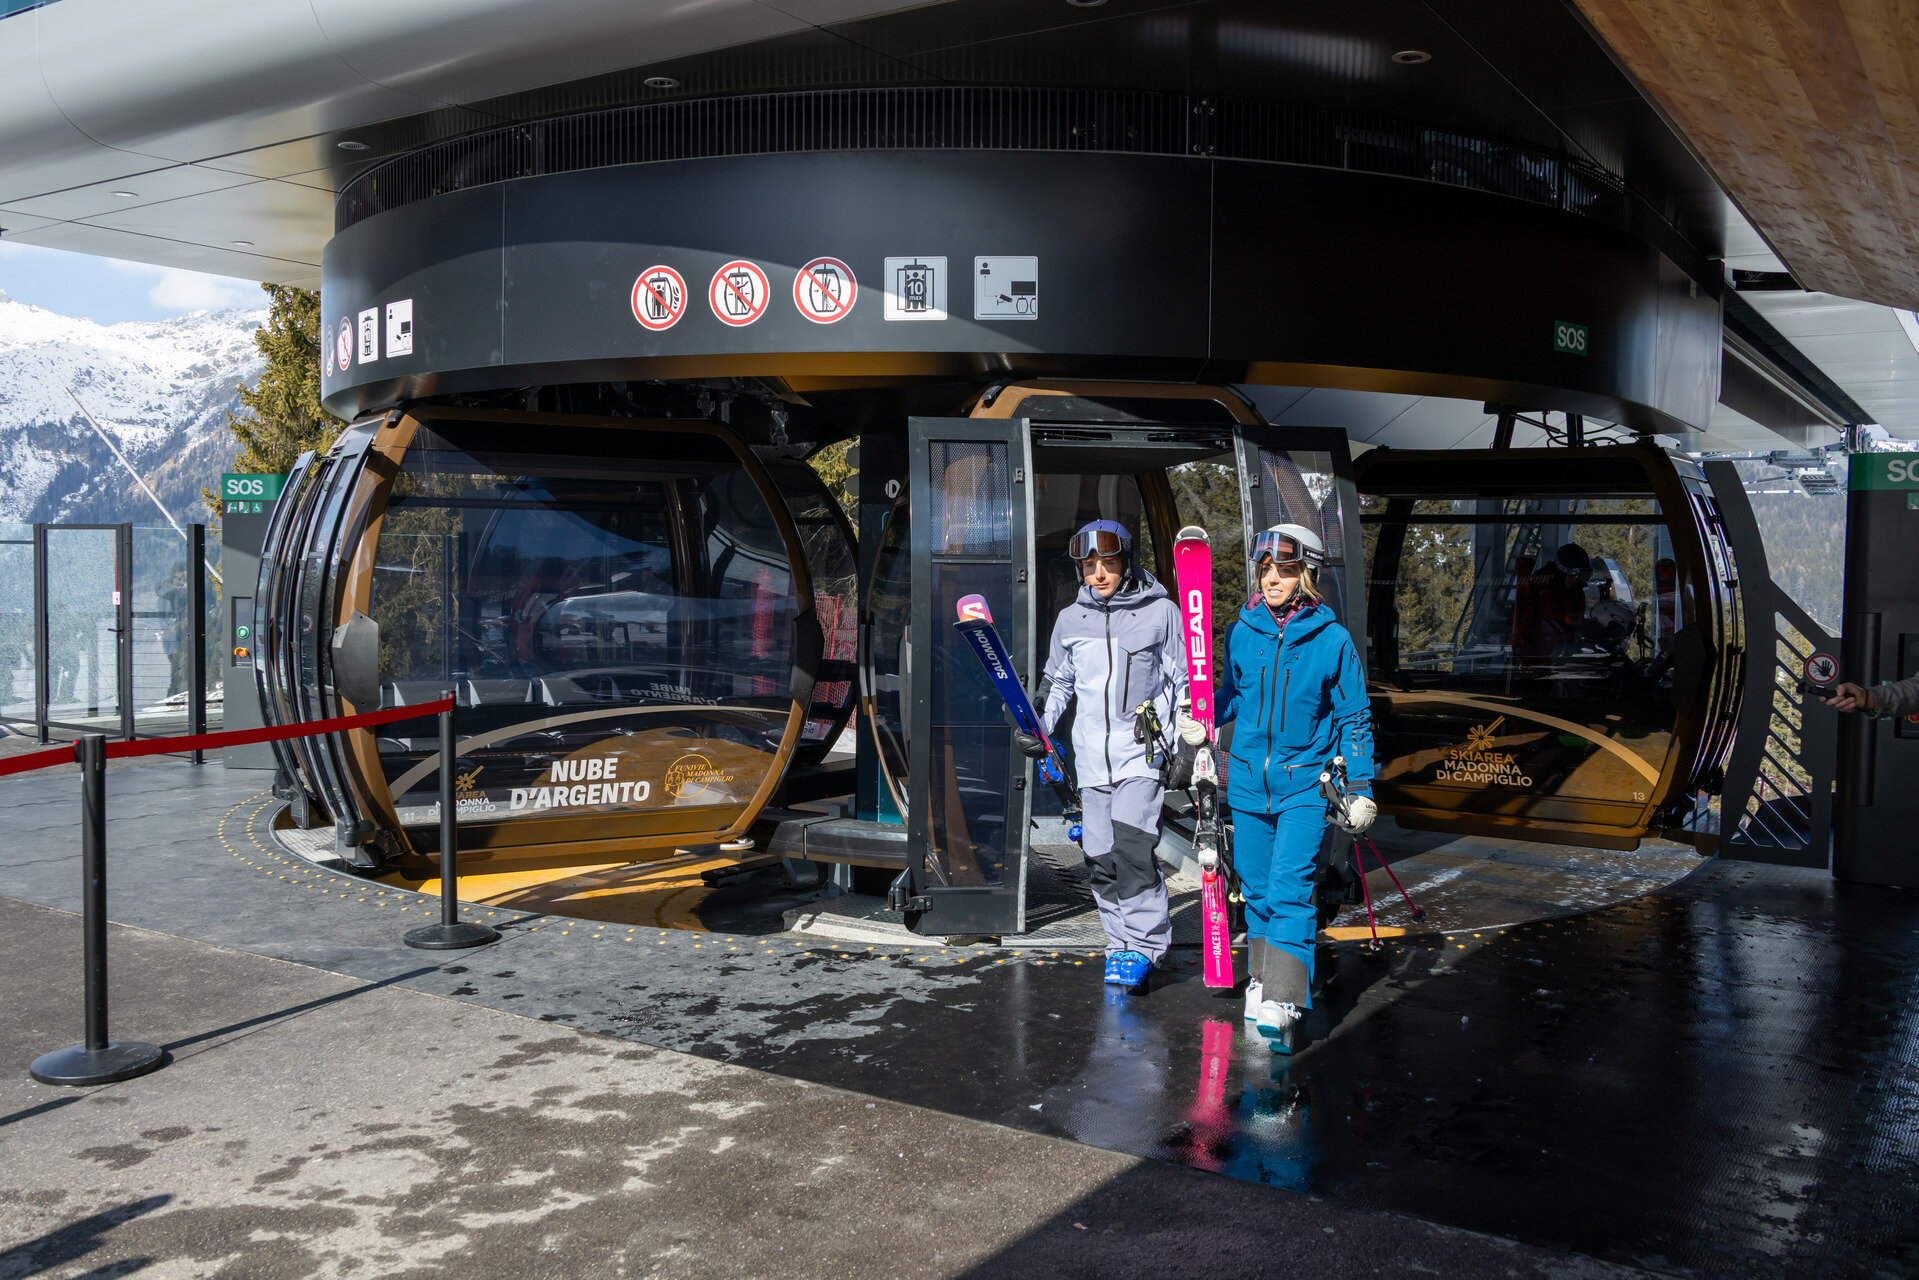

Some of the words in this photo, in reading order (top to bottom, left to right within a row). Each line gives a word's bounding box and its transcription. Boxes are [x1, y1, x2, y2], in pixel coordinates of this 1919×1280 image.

[907, 281, 924, 296] 10
[1557, 325, 1586, 351] SOS
[227, 479, 264, 495] SOS
[1188, 589, 1207, 682] HEAD
[973, 629, 1009, 679] SALOMON
[1450, 750, 1515, 764] SKIAREA
[550, 757, 619, 783] NUBE
[674, 763, 707, 772] FUNIVIE
[686, 769, 725, 777] MADONNA
[1444, 760, 1522, 776] MADONNA
[694, 775, 734, 783] CAMPIGLIO
[1436, 769, 1450, 781] DI
[1452, 771, 1533, 787] CAMPIGLIO
[509, 780, 651, 811] D'ARGENTO
[1632, 792, 1645, 801] 13
[1212, 936, 1222, 955] RACE
